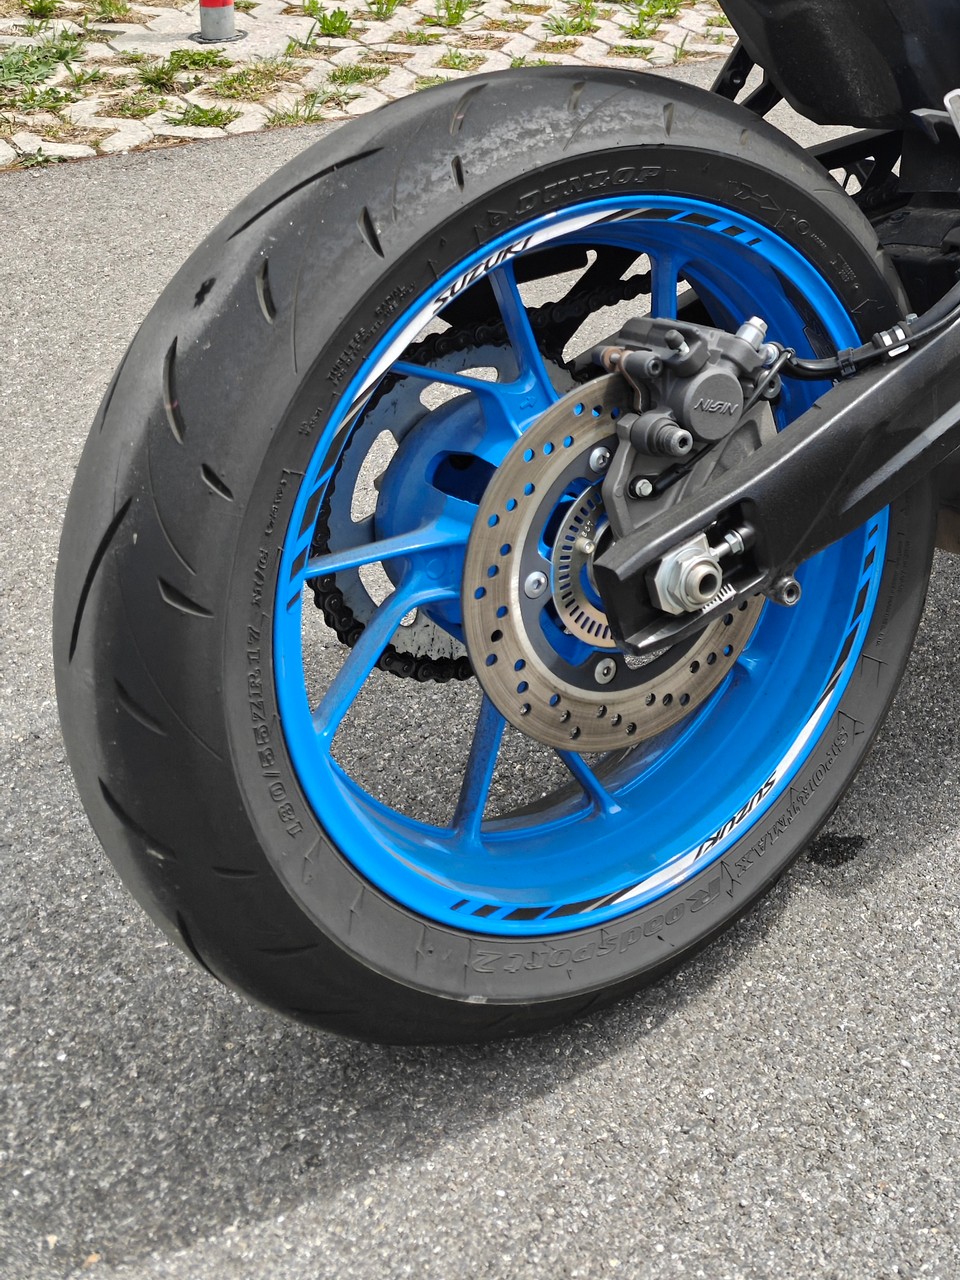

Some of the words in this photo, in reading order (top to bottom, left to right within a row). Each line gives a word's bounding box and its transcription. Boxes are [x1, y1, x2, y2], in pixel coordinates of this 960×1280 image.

[514, 165, 663, 213] DUNLOP
[432, 236, 535, 316] SUZUKI
[694, 768, 778, 862] SUZUKI
[731, 724, 850, 879] SPORTMAX
